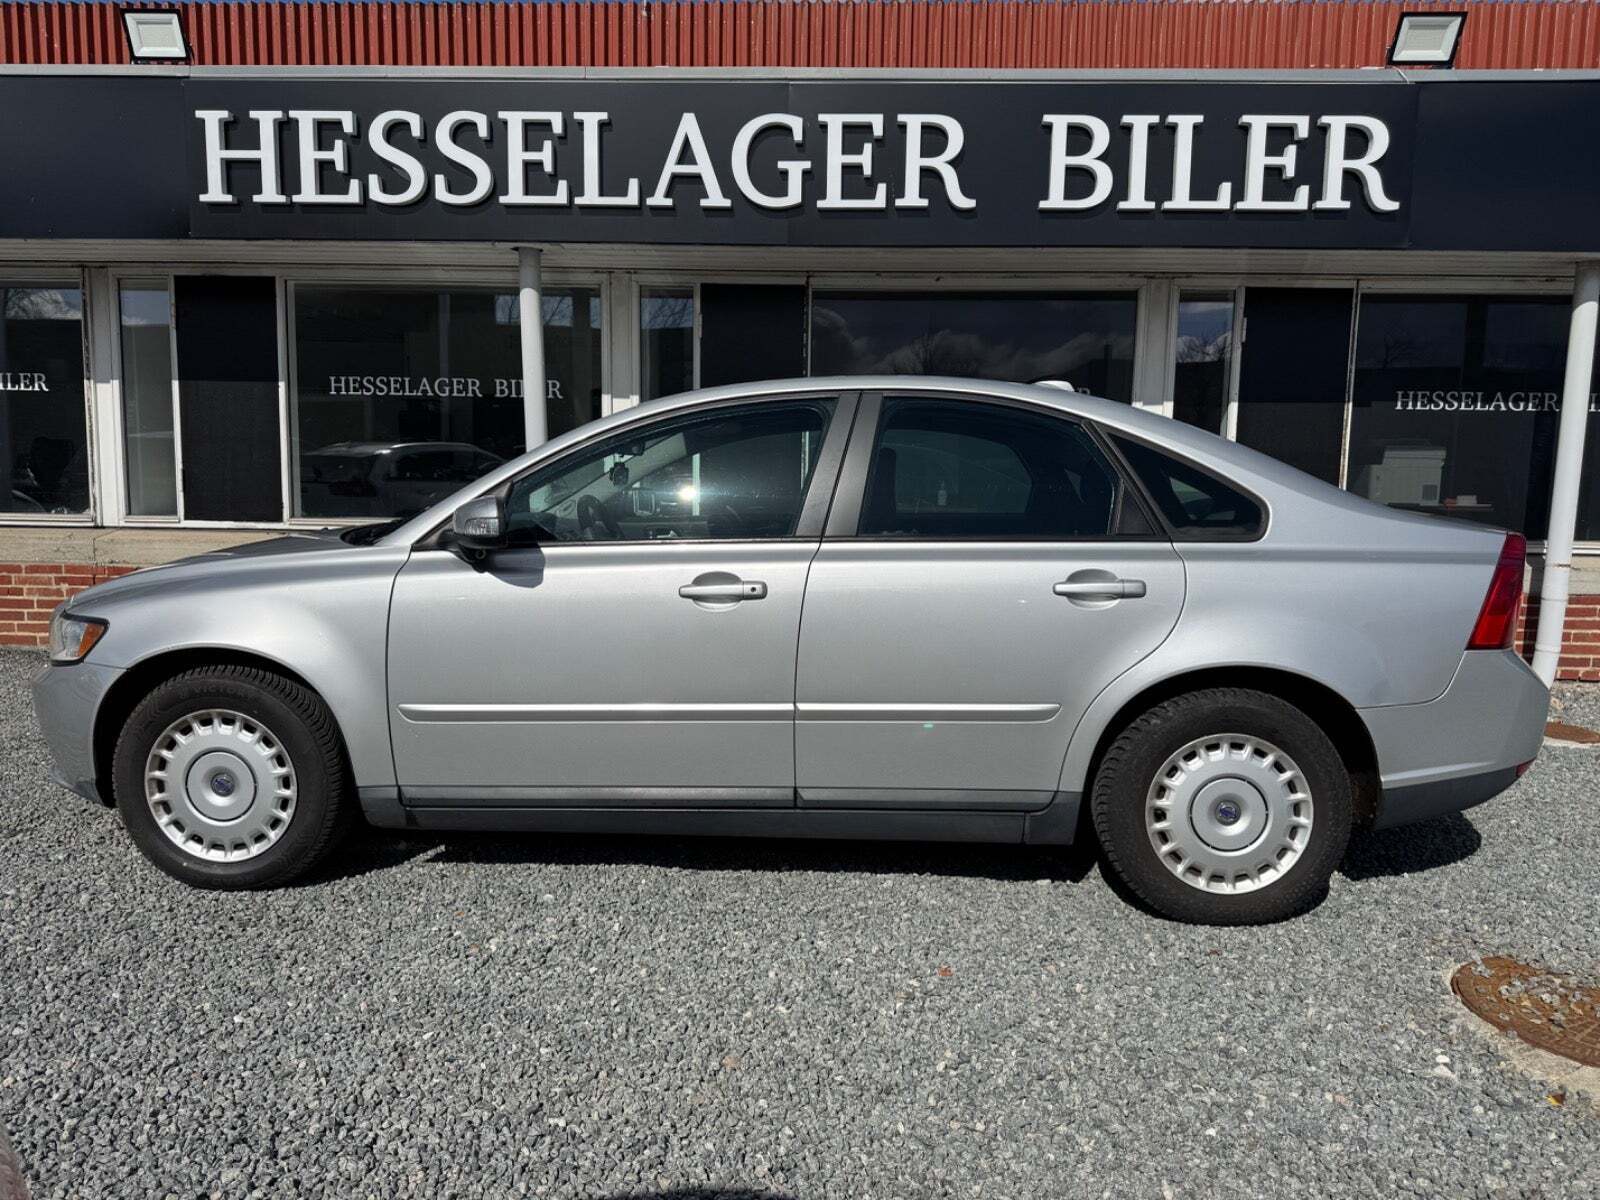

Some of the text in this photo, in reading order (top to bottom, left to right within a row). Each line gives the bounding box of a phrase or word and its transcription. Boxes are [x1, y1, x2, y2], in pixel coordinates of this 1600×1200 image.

[195, 110, 1401, 212] HESSELAGER BILER
[329, 376, 483, 397] HESSELAGER
[1394, 391, 1560, 412] HESSELAGER
